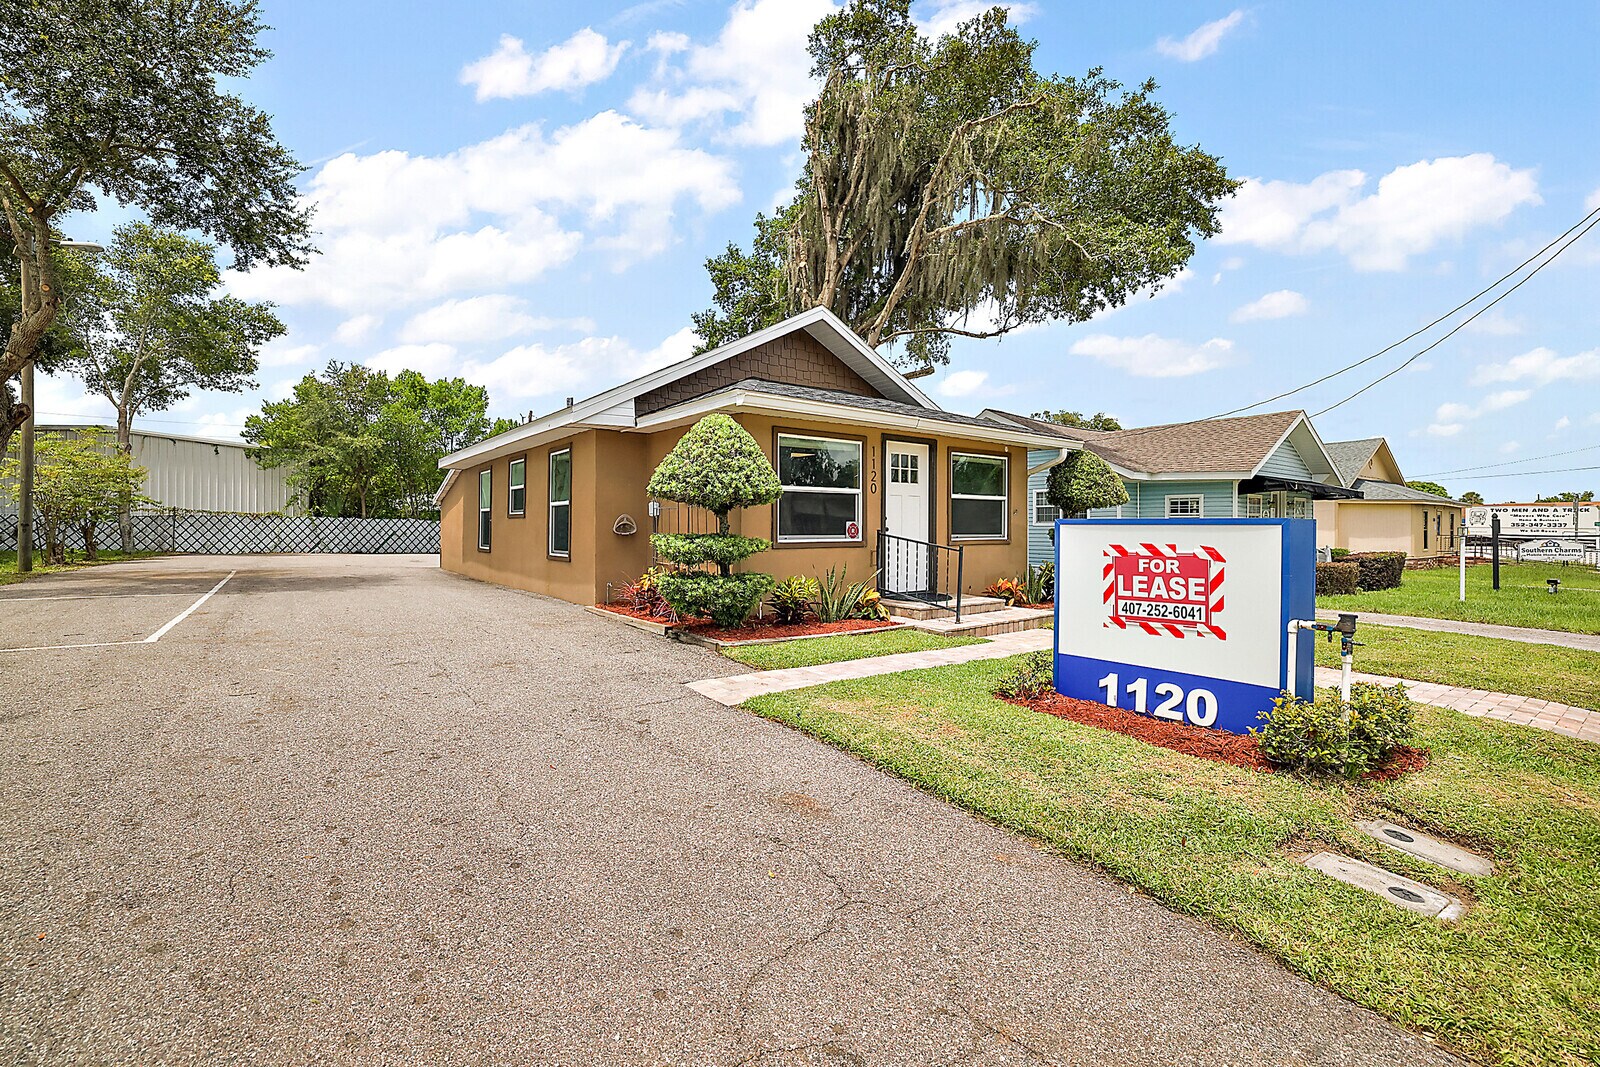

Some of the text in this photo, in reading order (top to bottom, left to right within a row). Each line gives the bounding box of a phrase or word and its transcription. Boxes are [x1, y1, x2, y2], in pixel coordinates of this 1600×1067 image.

[1138, 559, 1180, 574] FOR
[1117, 575, 1206, 601] LEASE
[1121, 602, 1202, 620] 407-252-6041
[1099, 673, 1218, 727] 1120
